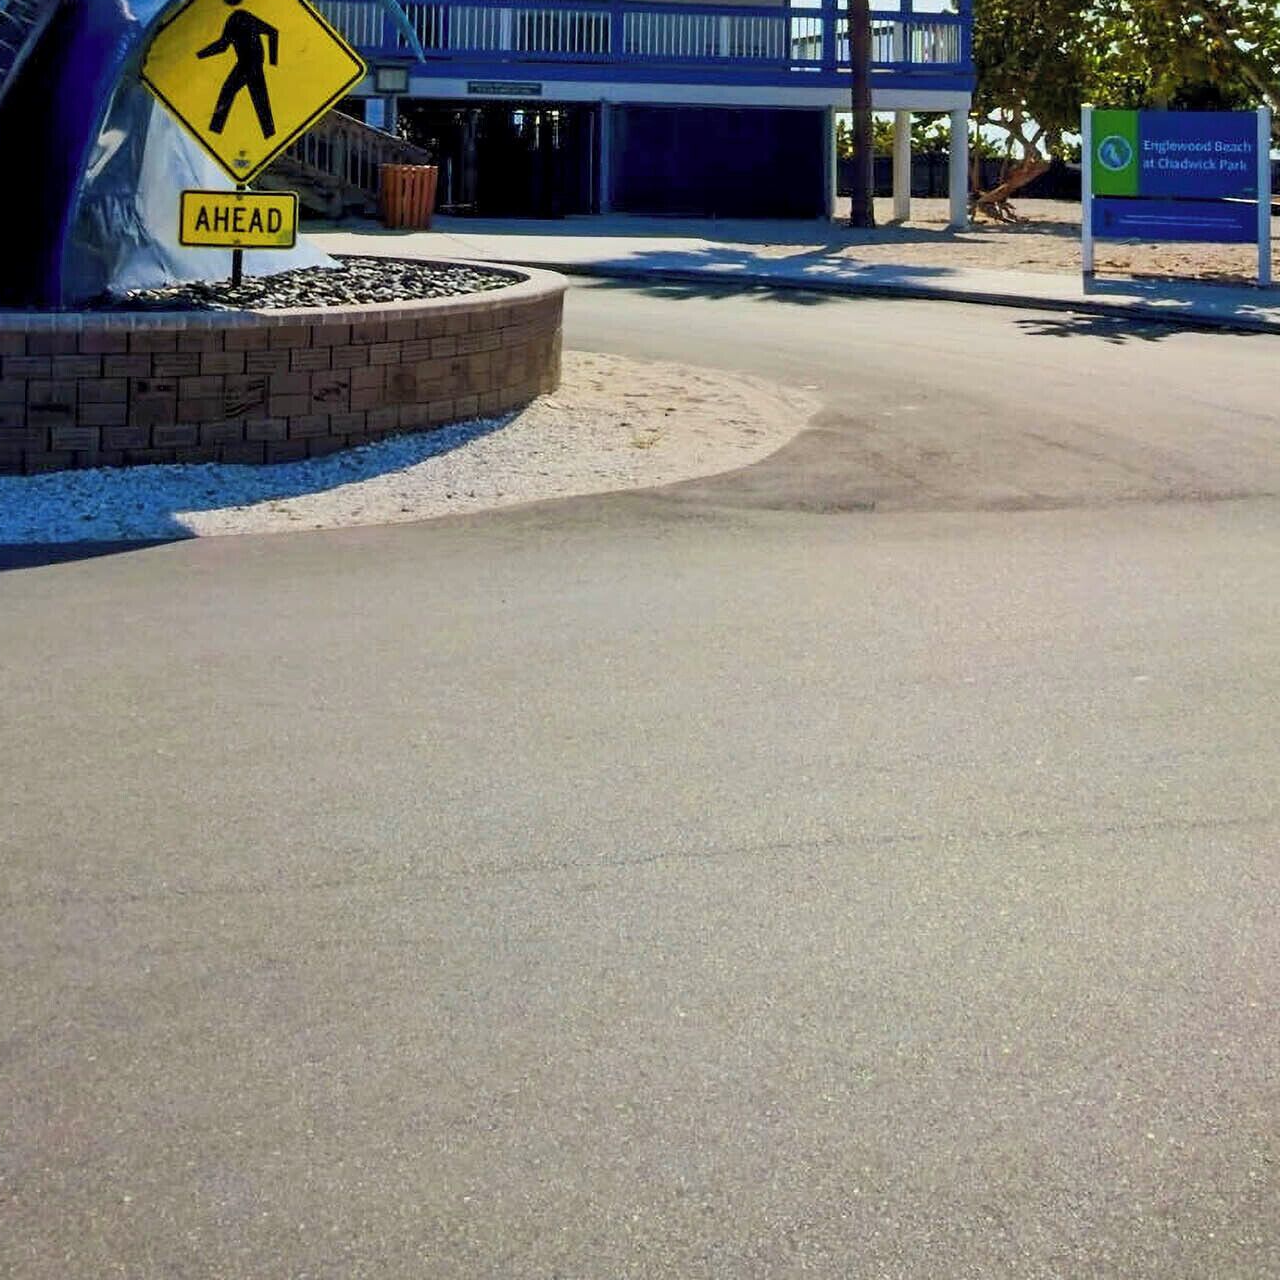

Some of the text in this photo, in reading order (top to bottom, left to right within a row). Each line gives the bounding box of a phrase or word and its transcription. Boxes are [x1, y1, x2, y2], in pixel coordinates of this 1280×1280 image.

[1143, 139, 1251, 154] Englewood Beach
[1143, 158, 1247, 170] at Chadwick Park
[195, 205, 282, 233] AHEAD
